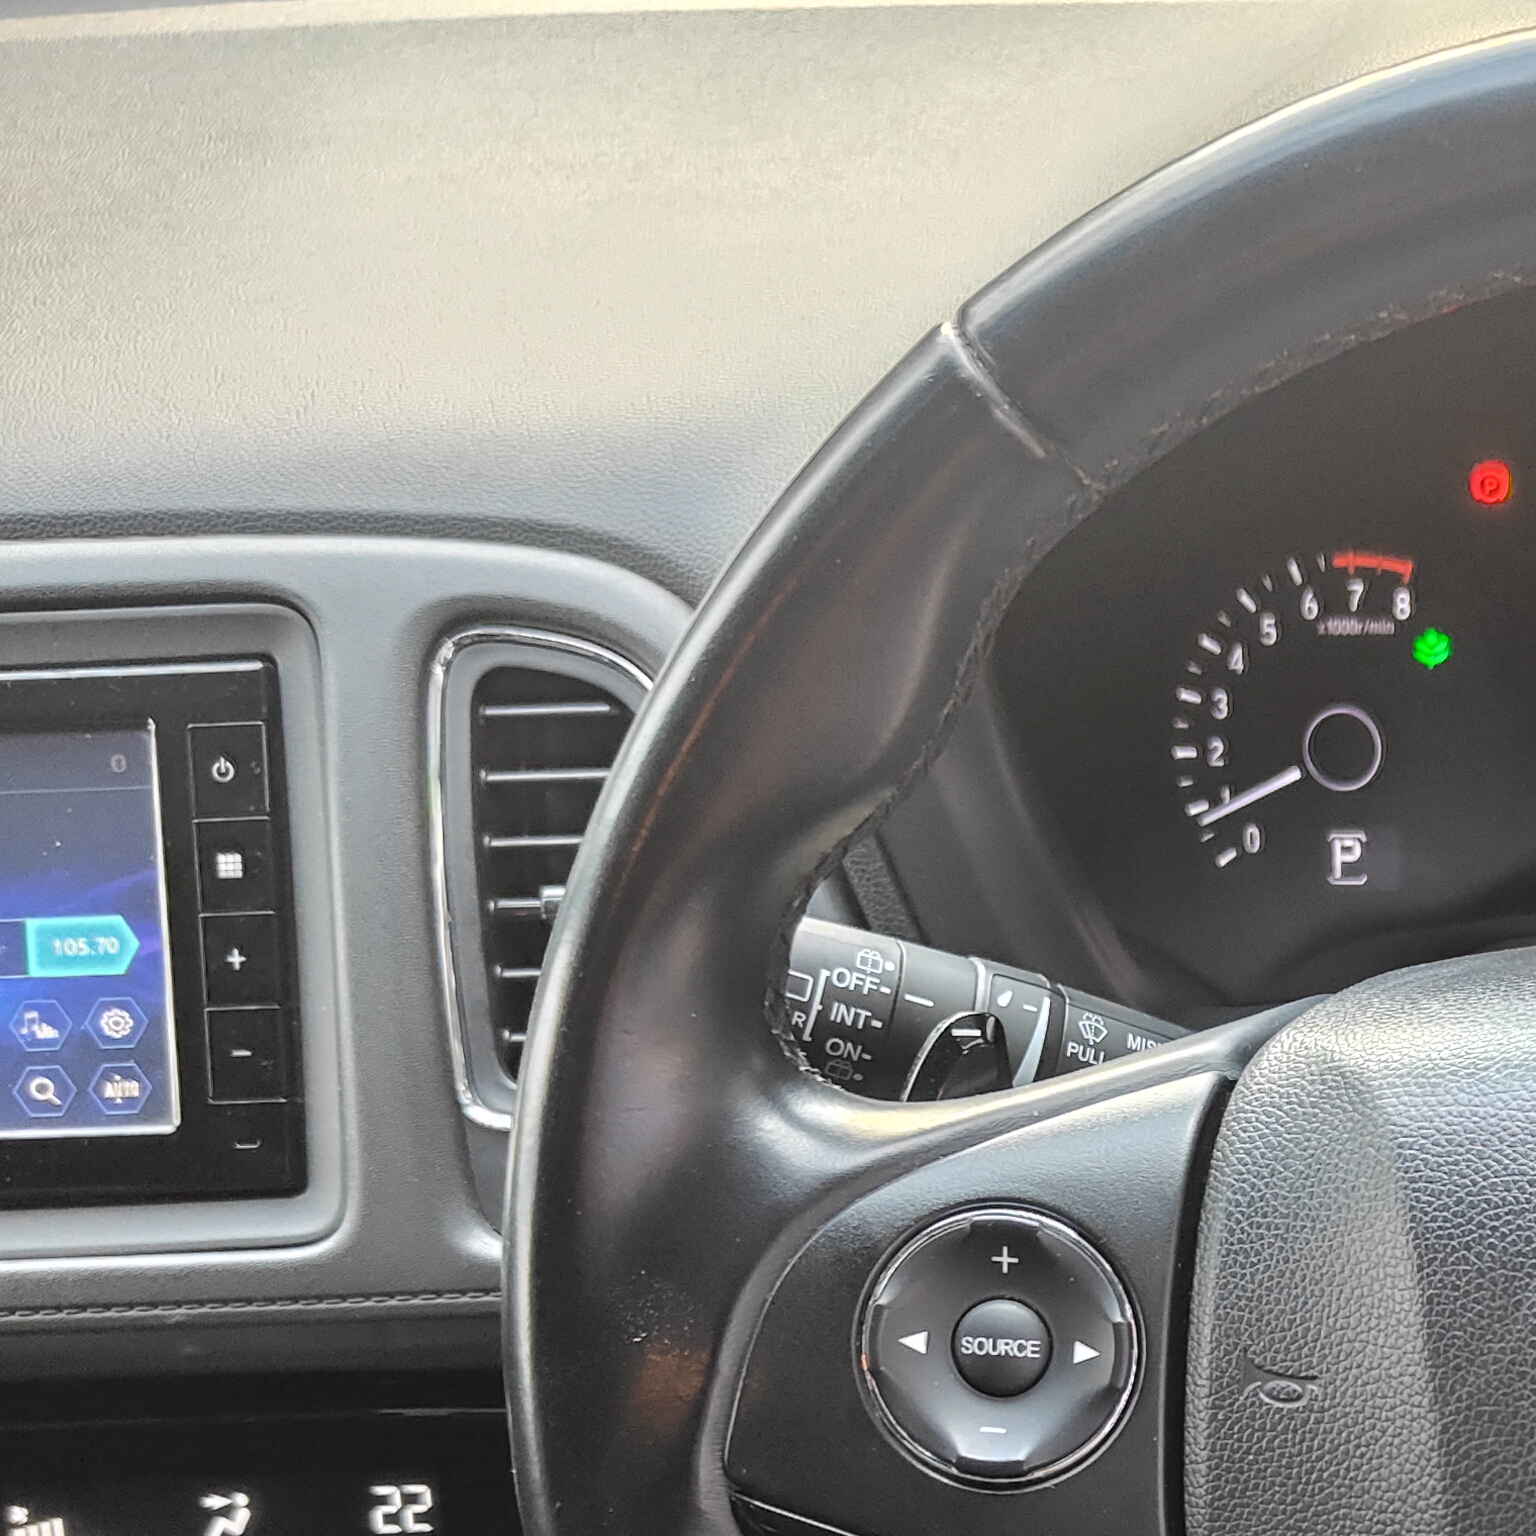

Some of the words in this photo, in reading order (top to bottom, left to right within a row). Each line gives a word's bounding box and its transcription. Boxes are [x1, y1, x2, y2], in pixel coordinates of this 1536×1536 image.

[1301, 586, 1319, 621] 6
[1345, 577, 1365, 613] 7
[1392, 586, 1413, 621] 8
[1258, 611, 1279, 646] 5
[1227, 641, 1246, 676] 4
[1210, 686, 1229, 721] 3
[1206, 735, 1226, 768] 2
[1242, 822, 1261, 854] 0
[960, 1336, 1042, 1359] SOURCE
[367, 1483, 435, 1535] 22
